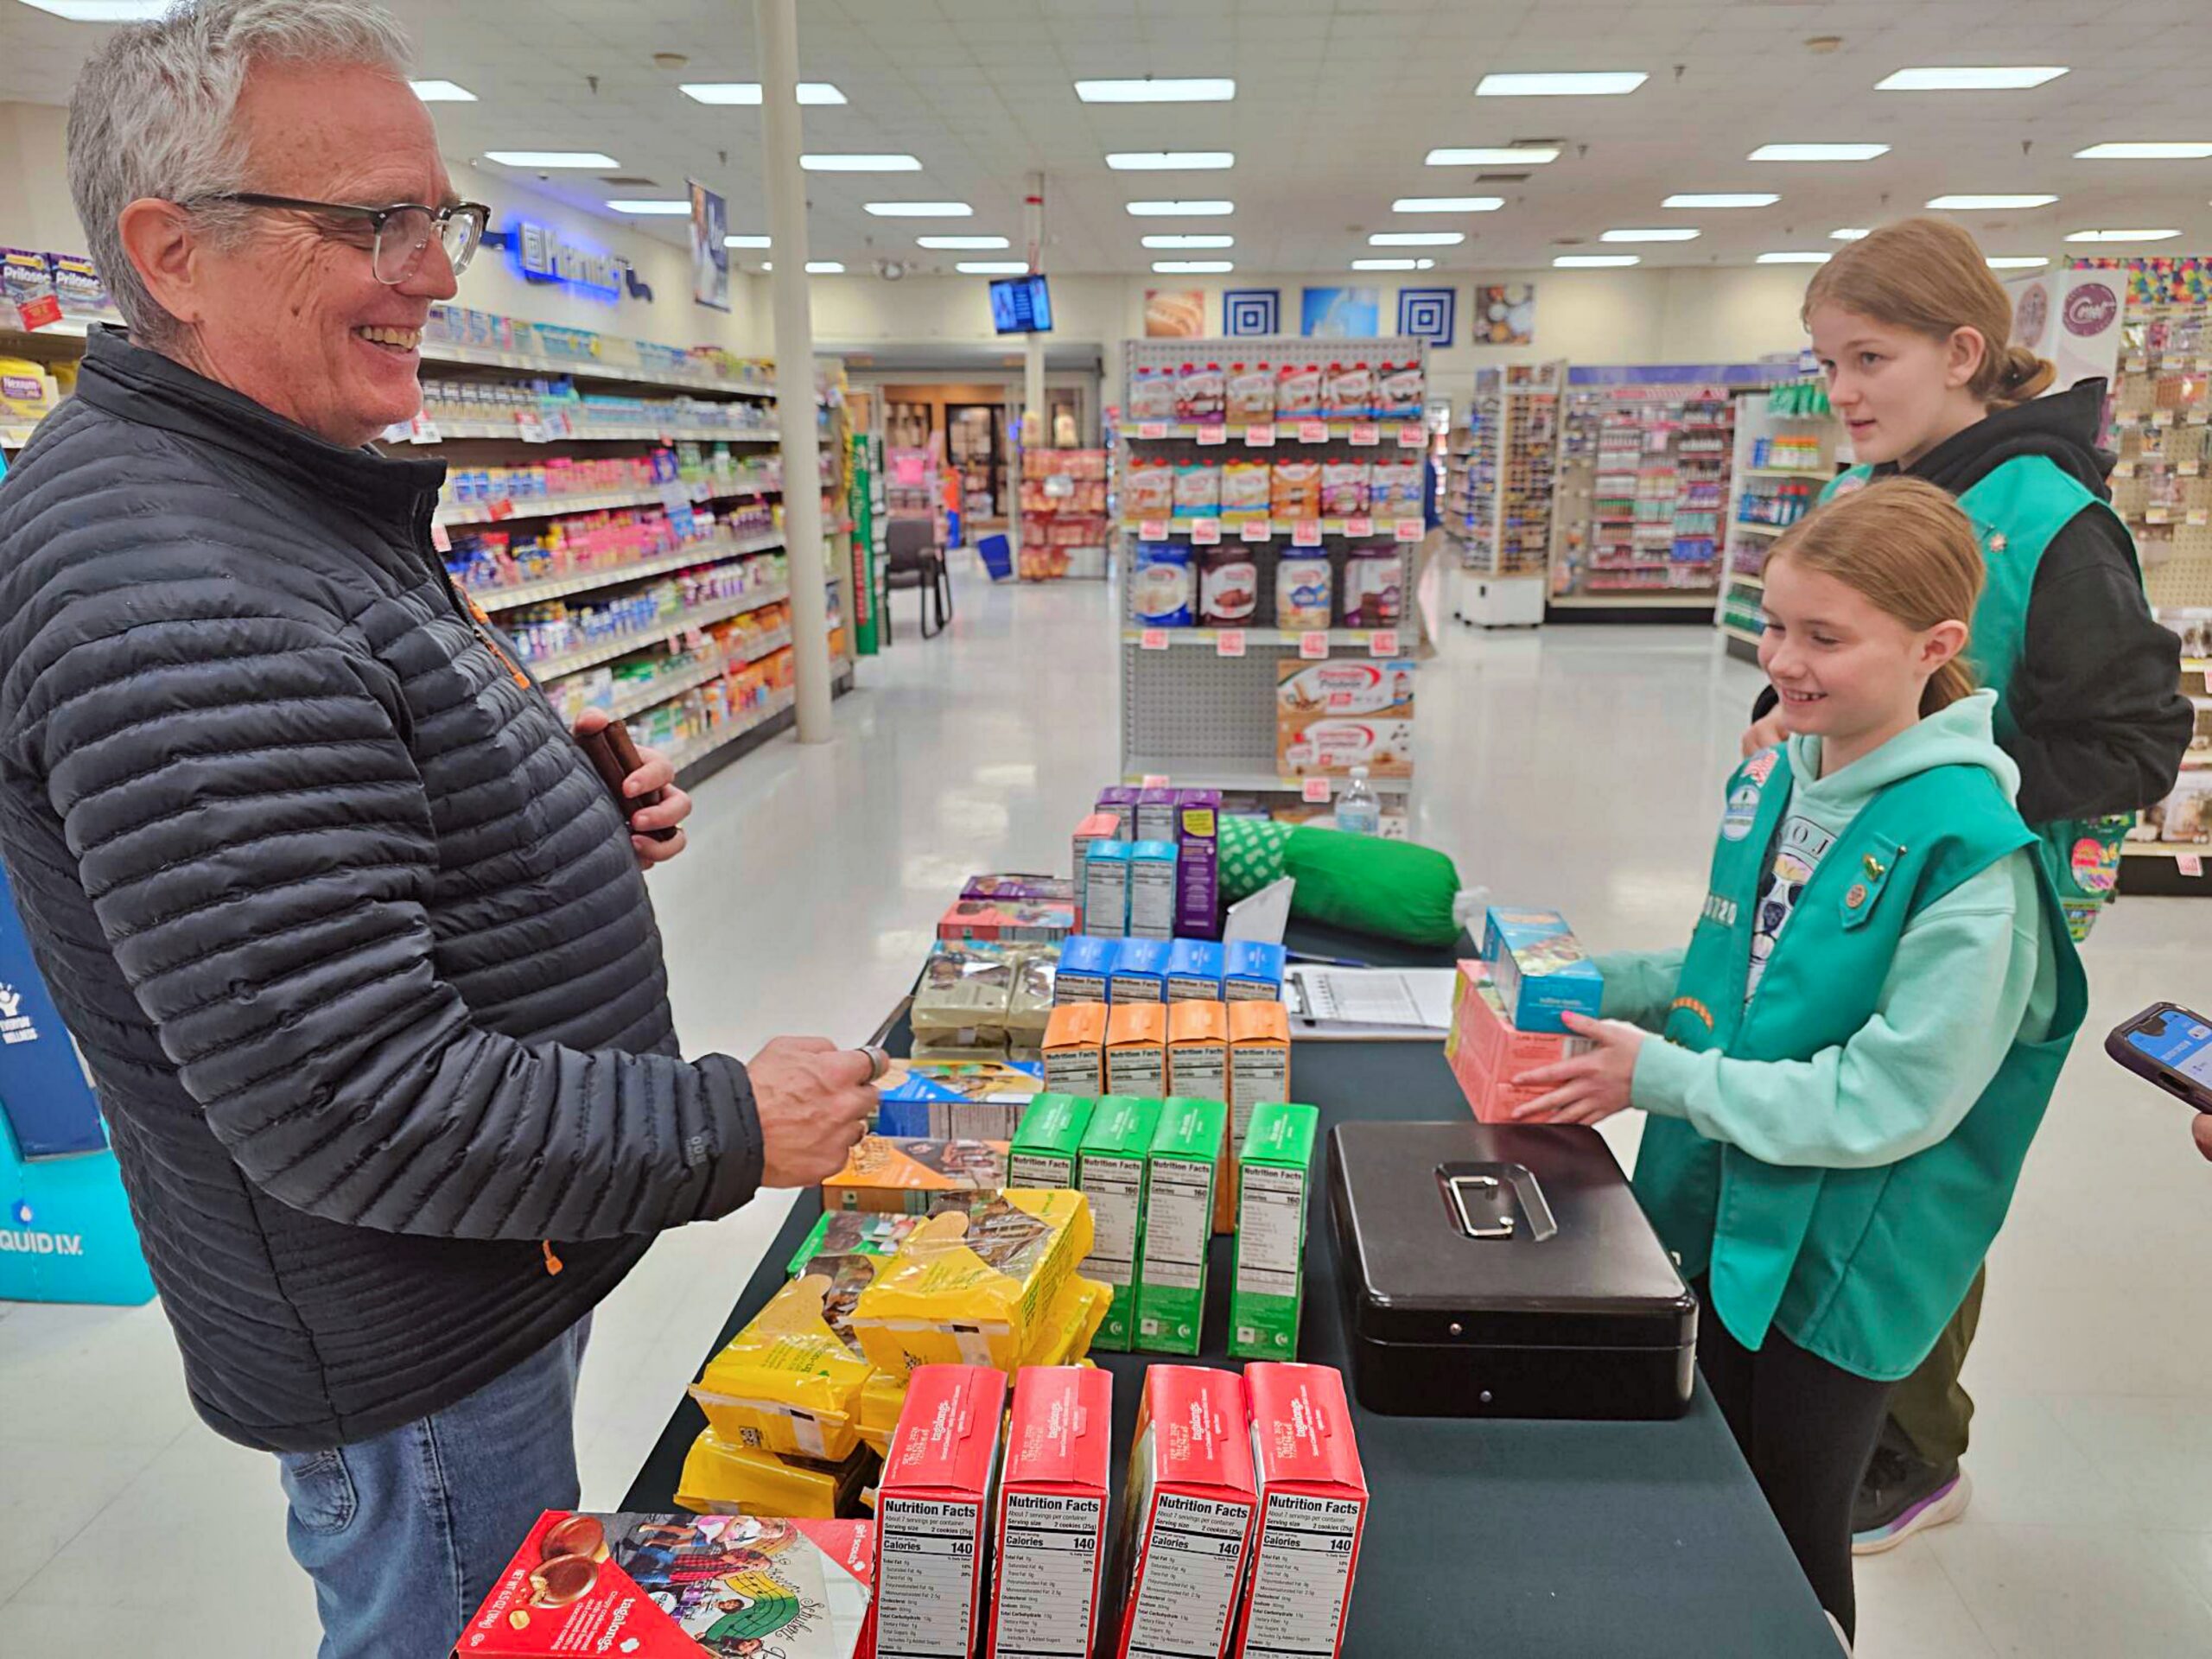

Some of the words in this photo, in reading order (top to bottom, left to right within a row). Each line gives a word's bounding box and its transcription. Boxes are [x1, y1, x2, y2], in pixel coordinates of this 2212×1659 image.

[1014, 1156, 1046, 1166] Nutrition
[1048, 1160, 1069, 1169] Facts
[1084, 1158, 1117, 1168] Nutrition
[1120, 1161, 1141, 1170] Facts
[1153, 1160, 1186, 1171] Nutrition
[1188, 1164, 1210, 1173] Facts
[1244, 1167, 1278, 1178] Nutrition
[1281, 1171, 1302, 1180] Facts
[886, 1500, 938, 1516] Nutrition
[943, 1504, 976, 1517] Facts
[1008, 1496, 1062, 1510] Nutrition
[1065, 1499, 1099, 1513] Facts
[1159, 1495, 1211, 1514] Nutrition
[1215, 1503, 1248, 1518] Facts
[1269, 1495, 1322, 1512] Nutrition
[1325, 1501, 1358, 1515] Facts
[1156, 1510, 1173, 1518] About
[884, 1522, 906, 1531] Serving
[1155, 1518, 1177, 1528] Serving
[1267, 1518, 1288, 1527] Serving
[855, 1523, 867, 1539] girl
[883, 1540, 921, 1551] Calories
[950, 1542, 973, 1554] 140
[1006, 1535, 1044, 1547] Calories
[1073, 1537, 1095, 1549] 140
[1152, 1535, 1189, 1549] Calories
[1218, 1542, 1239, 1555] 140
[1263, 1535, 1301, 1548] Calories
[1330, 1539, 1351, 1551] 140
